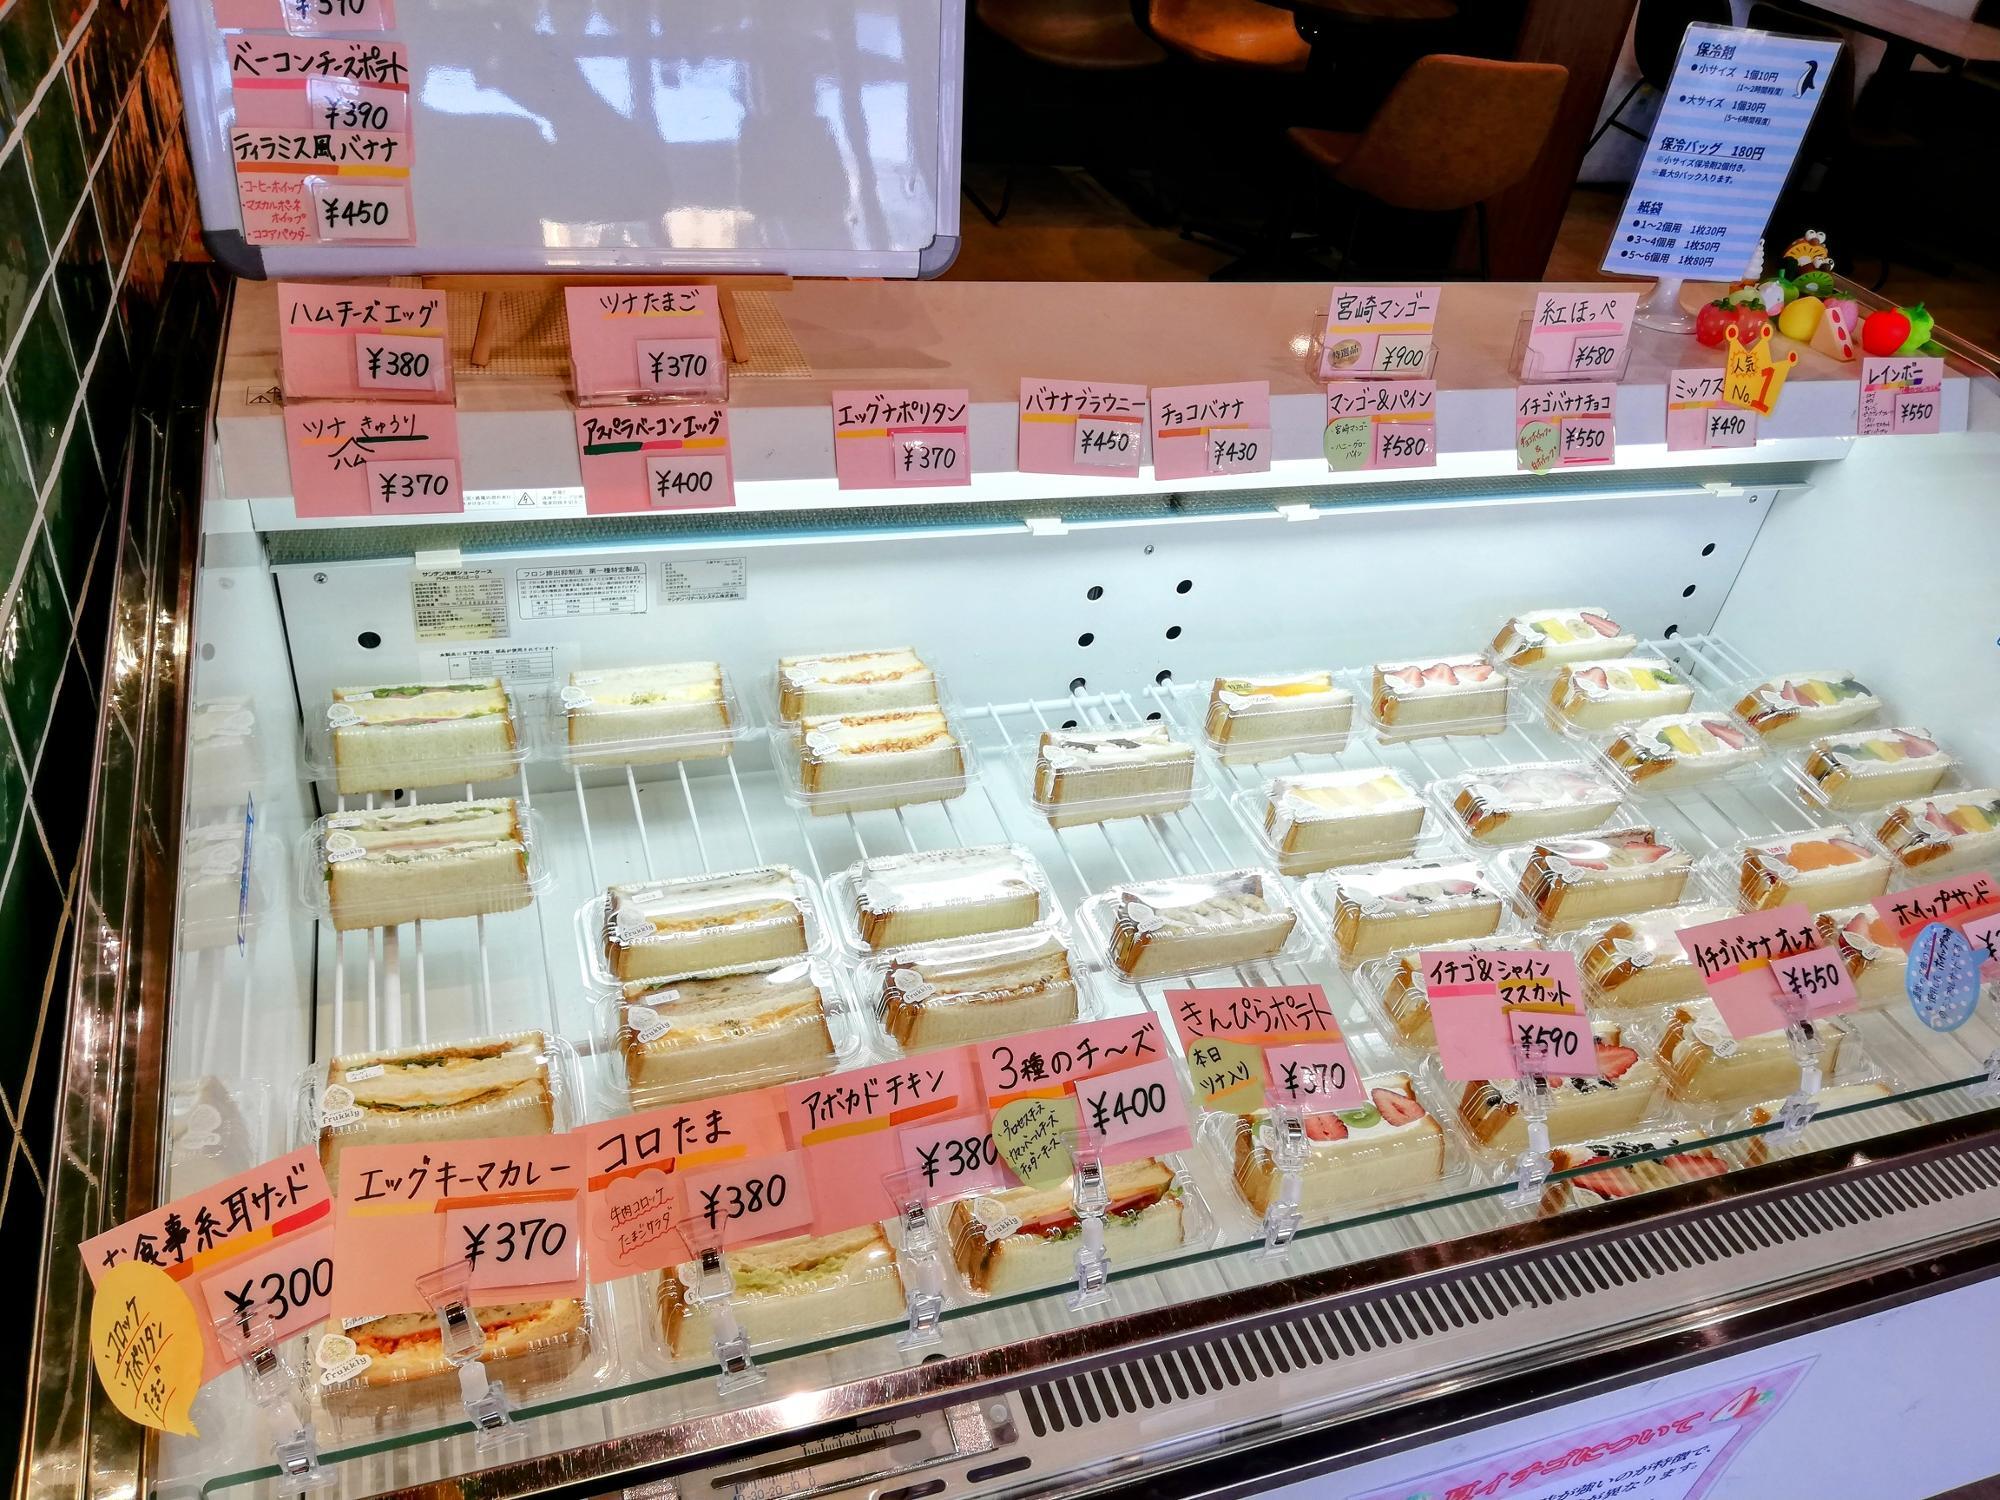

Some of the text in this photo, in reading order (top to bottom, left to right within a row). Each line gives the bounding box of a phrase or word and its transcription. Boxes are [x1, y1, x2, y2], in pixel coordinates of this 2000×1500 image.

[233, 42, 408, 84] ベーコンチーズポテト
[1696, 41, 1737, 60] 保冷剤
[1698, 65, 1779, 83] 小サイズ 1個10円
[324, 96, 388, 130] ¥390
[1686, 95, 1766, 113] 大サイズ 1個30円
[233, 134, 398, 162] ティラミス風バナナ
[1660, 137, 1765, 160] 保冷バッグ 180円
[321, 198, 389, 228] ¥450
[1637, 200, 1663, 215] 紙袋
[1690, 224, 1727, 237] 1枚30円
[1684, 239, 1720, 252] 1枚50円
[1678, 255, 1714, 267] 1枚80円
[289, 301, 439, 328] ハムチーズエッグ
[600, 289, 700, 314] ツナたまご
[1337, 290, 1431, 323] 宮崎マンゴー
[1539, 298, 1617, 326] 紅ほっぺ
[366, 347, 430, 379] ¥380
[650, 355, 708, 382] ¥370
[1384, 345, 1424, 371] ¥900
[1575, 345, 1615, 369] ¥580
[1733, 356, 1756, 374] 人気
[1868, 362, 1923, 385] レインボー
[1025, 388, 1146, 413] バナナブラウニー
[1330, 387, 1432, 415] マンゴー&パイン
[1675, 378, 1724, 399] ミックス
[838, 395, 967, 427] エッグナポリタン
[1161, 399, 1244, 422] チョコバナナ
[1520, 391, 1611, 413] イチゴバナナチョコ
[1901, 403, 1933, 424] ¥550
[583, 411, 724, 440] アスパラベーコンエッグ
[1565, 427, 1605, 449] ¥550
[1711, 415, 1746, 437] ¥490
[1081, 429, 1130, 452] ¥450
[1215, 440, 1258, 465] ¥430
[1383, 433, 1426, 456] ¥580
[903, 447, 956, 471] ¥370
[380, 473, 448, 503] ¥370
[656, 472, 714, 497] ¥400
[1890, 879, 1990, 926] ホイップサンド
[1695, 926, 1816, 977] イチゴバナナオレオ
[906, 985, 933, 1000] frukkly
[1500, 980, 1571, 1006] マスカット
[1783, 963, 1839, 998] ¥550
[1179, 992, 1333, 1038] きんぴらポテト
[641, 1021, 671, 1041] frukkly
[1517, 1024, 1578, 1059] ¥590
[1193, 1047, 1222, 1067] 本日
[1199, 1061, 1250, 1092] ツナ入り
[1280, 1061, 1346, 1098] ¥370
[802, 1069, 945, 1131] アボカドチキン
[1087, 1083, 1165, 1135] ¥400
[323, 1110, 360, 1124] frukkly
[597, 1110, 733, 1173] コロたま
[916, 1131, 999, 1188] ¥380
[354, 1155, 571, 1201] エッグキーマカレー
[611, 1187, 664, 1224] 牛肉コロッケ
[700, 1174, 788, 1228] ¥380
[988, 1217, 1019, 1237] frukkly
[462, 1218, 568, 1265] ¥370
[224, 1258, 334, 1338] ¥300
[326, 1357, 367, 1382] frukkly
